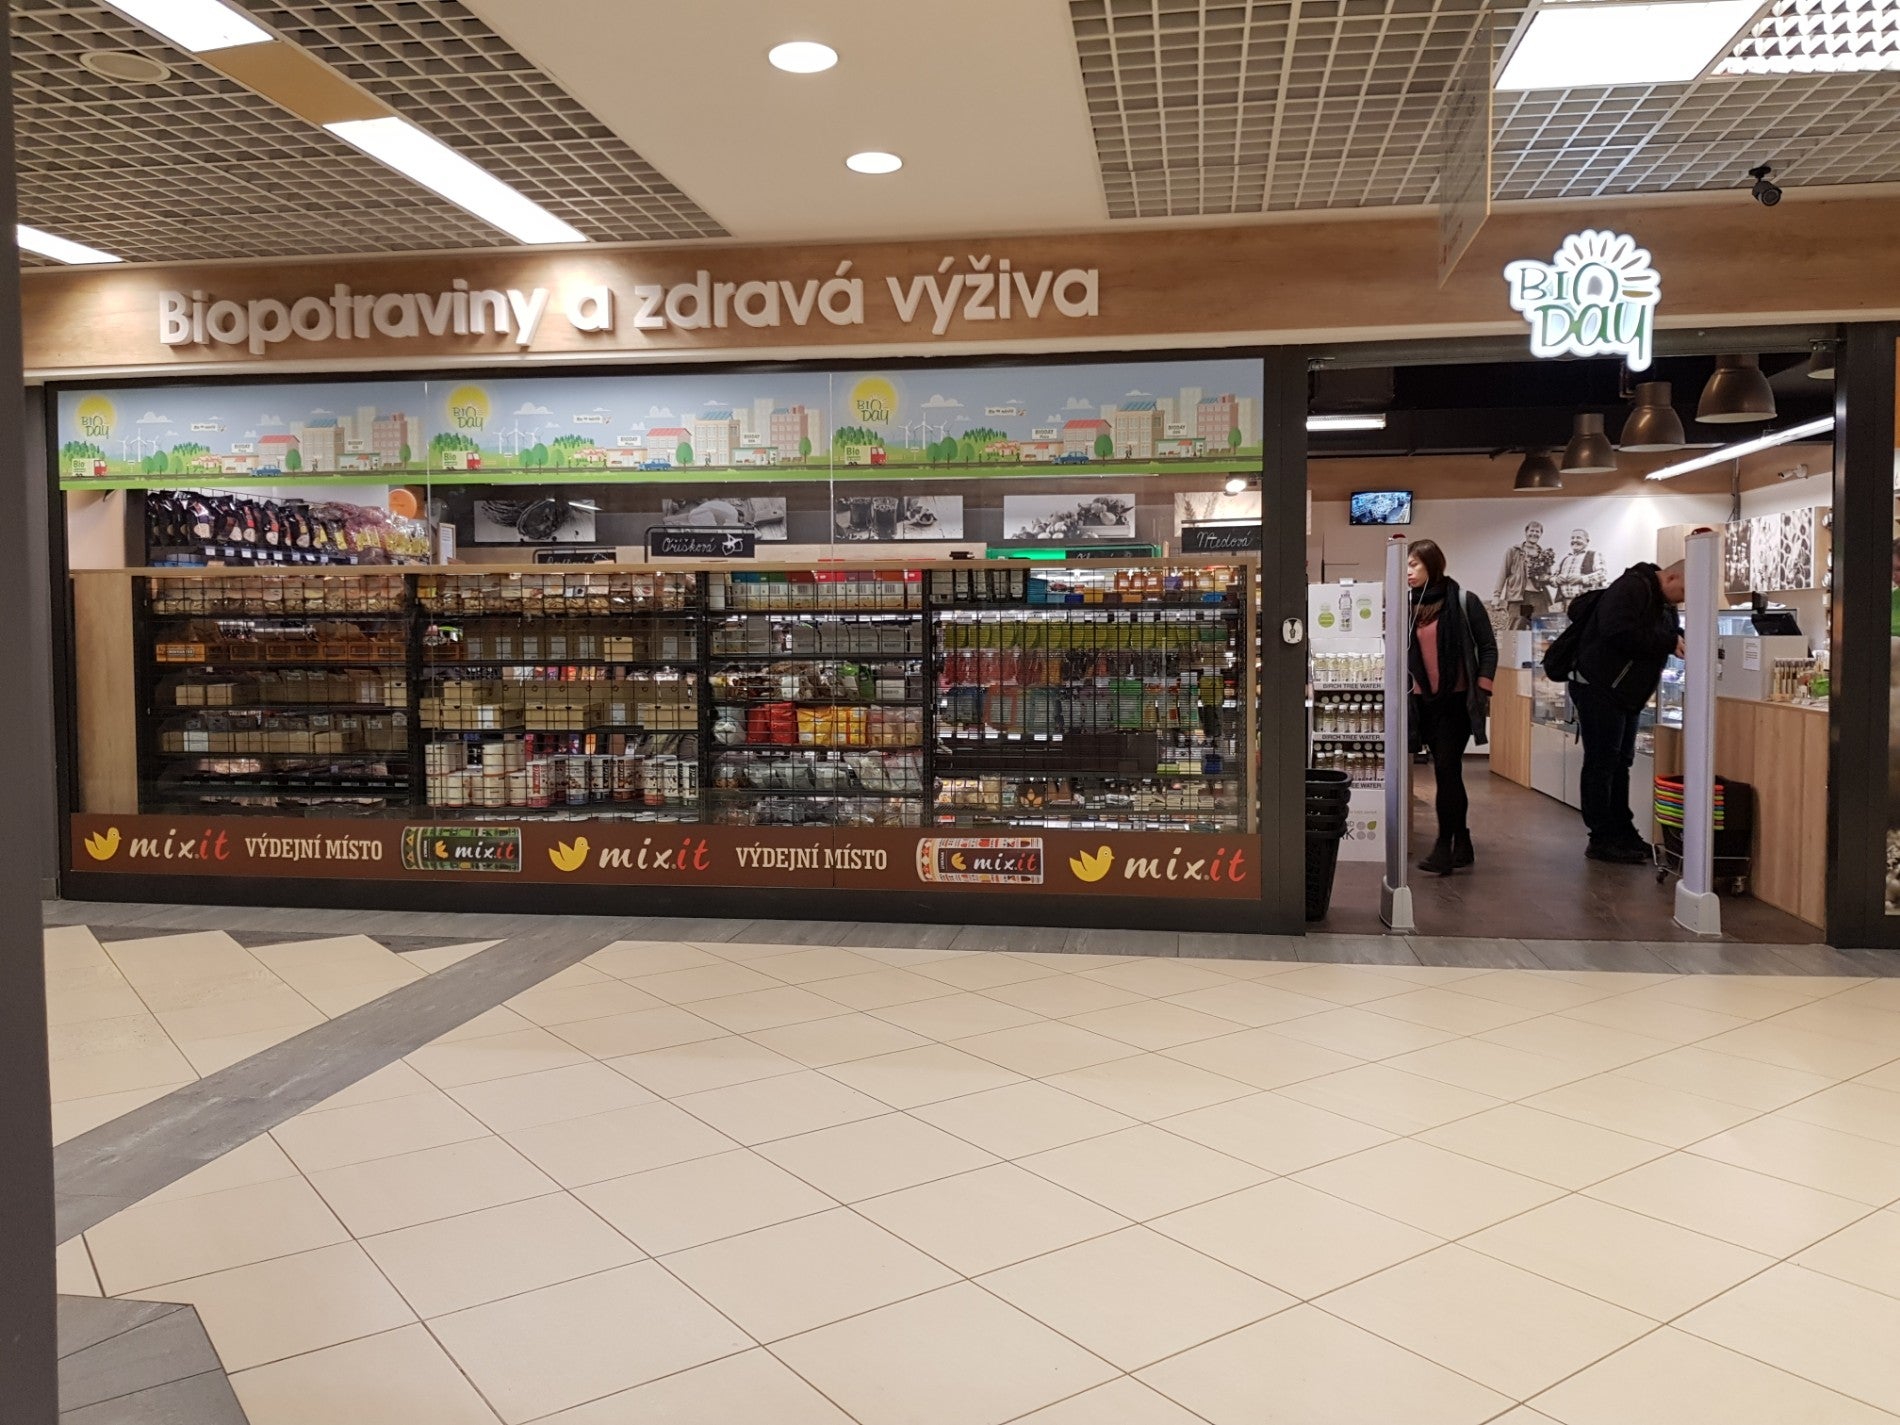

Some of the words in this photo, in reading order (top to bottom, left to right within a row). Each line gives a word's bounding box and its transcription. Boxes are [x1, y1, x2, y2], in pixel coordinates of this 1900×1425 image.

[1520, 262, 1619, 306] BIO
[159, 278, 549, 355] Biopotraviny
[566, 285, 612, 331] a
[633, 260, 864, 330] zdravá
[885, 254, 1099, 335] výživa
[129, 828, 230, 861] mix.it
[245, 832, 321, 862] VÝDEJNÍ
[325, 834, 383, 861] MÍSTO
[599, 837, 710, 871] mix.it
[736, 842, 820, 872] VÝDEJNÍ
[824, 843, 887, 871] MÍSTO
[1124, 846, 1247, 882] mix.it
